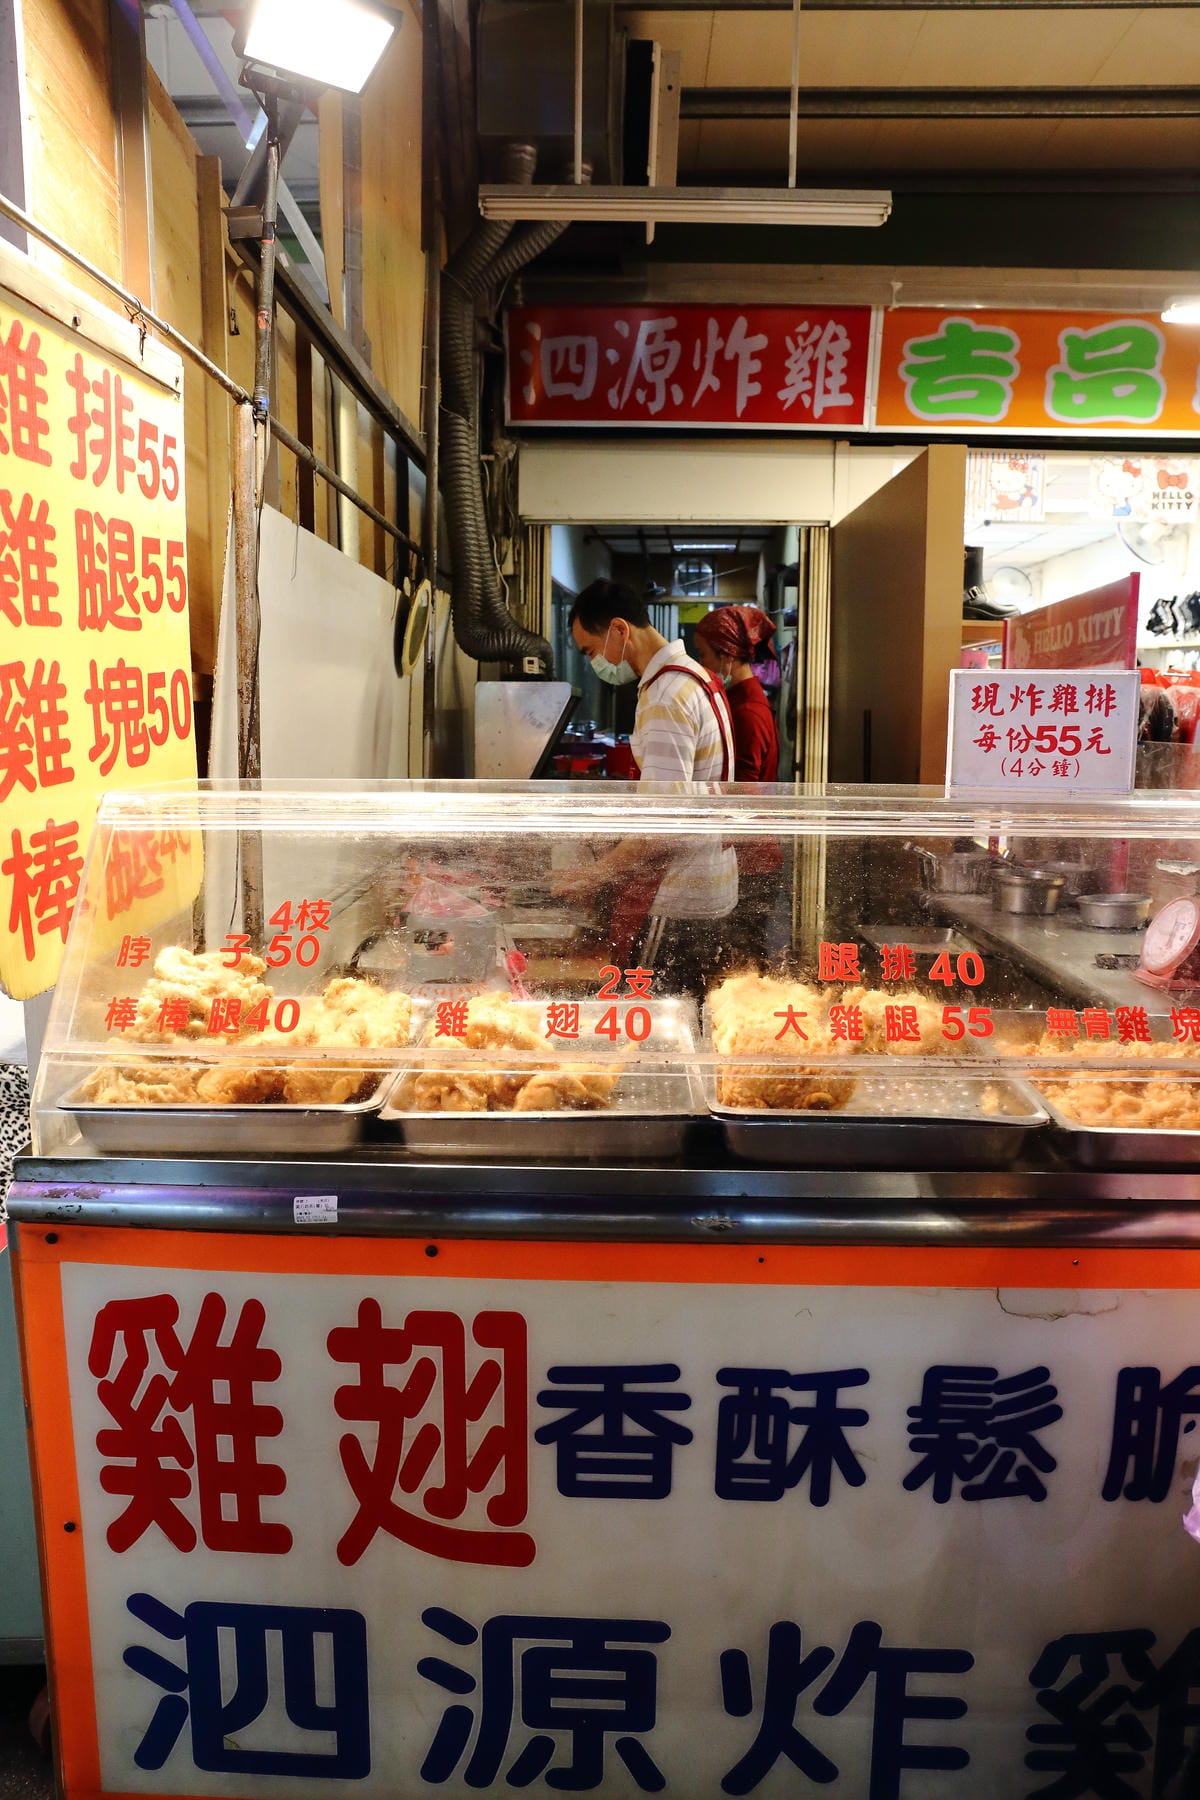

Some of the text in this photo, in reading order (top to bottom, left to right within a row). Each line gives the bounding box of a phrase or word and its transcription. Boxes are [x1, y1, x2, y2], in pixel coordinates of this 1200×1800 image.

[522, 316, 855, 419] 泗源炸雞
[898, 316, 1200, 425] 吉品
[1152, 502, 1192, 510] KITTY
[1153, 491, 1193, 500] HELLO
[1034, 605, 1125, 655] HELLO KITTY
[971, 682, 1118, 717] 現炸雞排
[972, 724, 1112, 757] 每份55元
[268, 899, 332, 933] 4枝
[597, 966, 654, 1000] 2支
